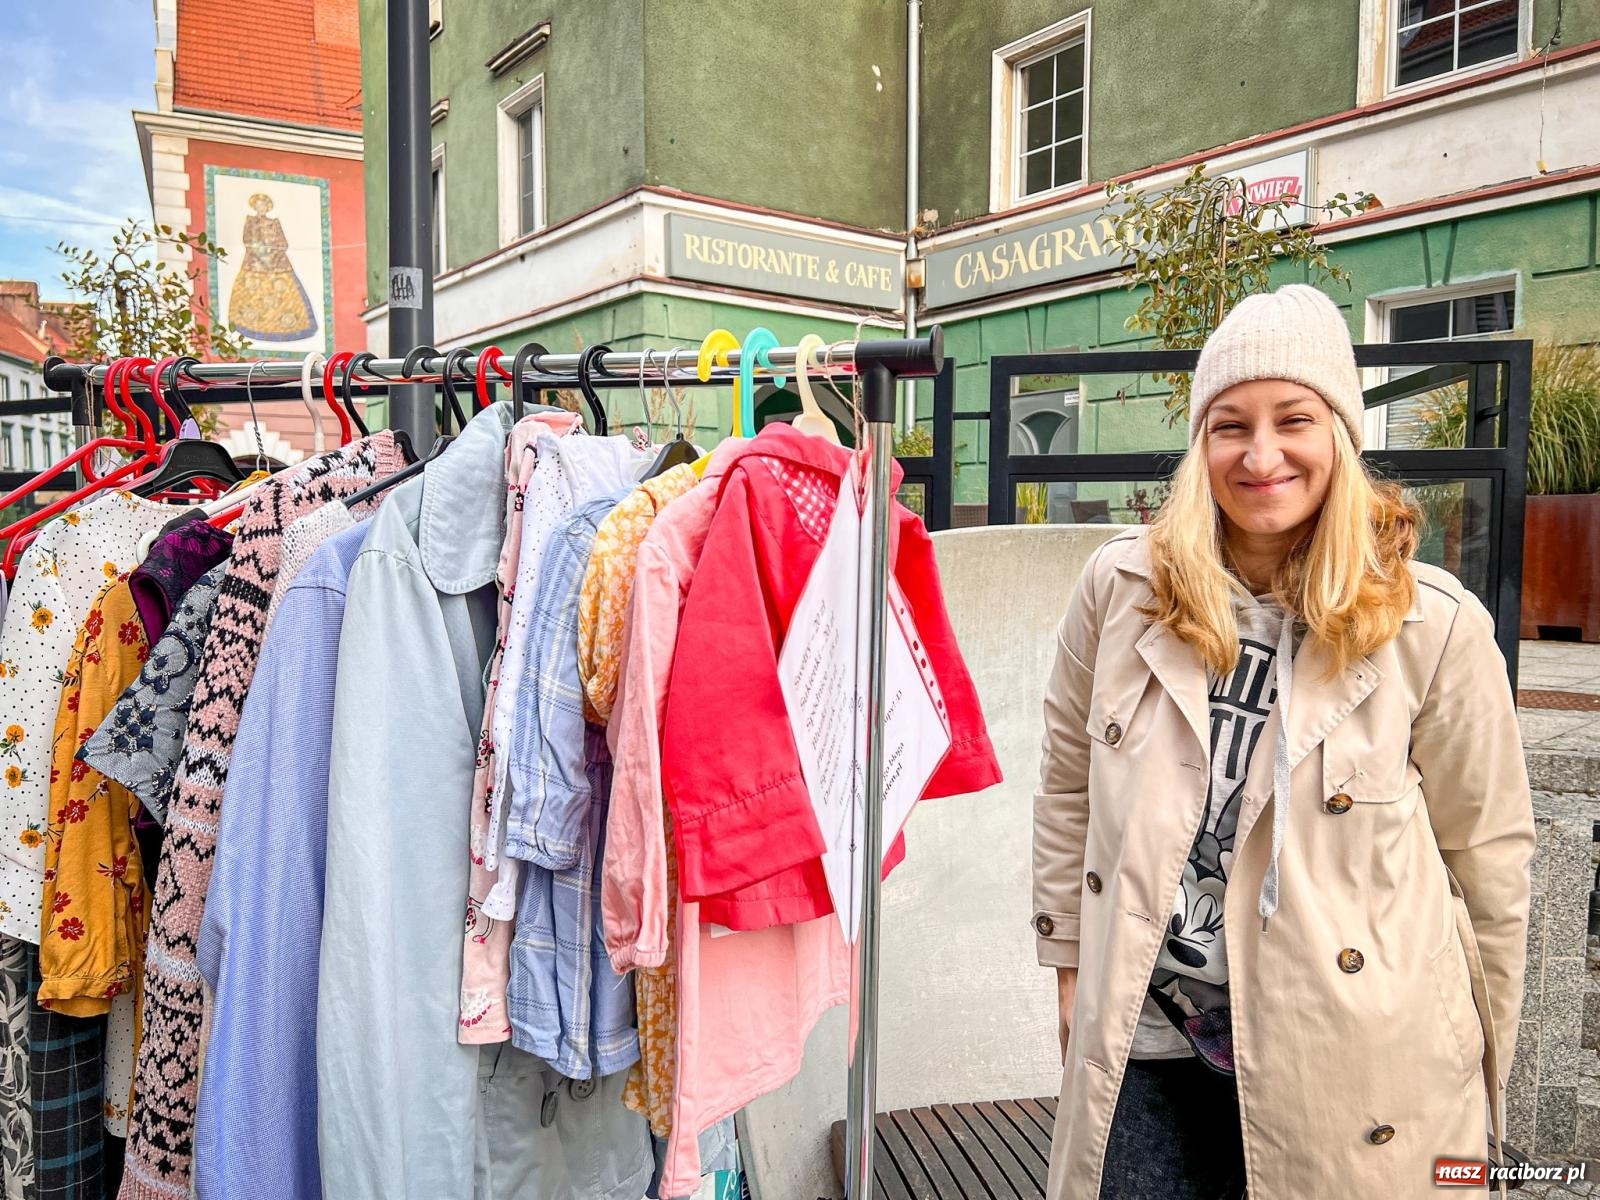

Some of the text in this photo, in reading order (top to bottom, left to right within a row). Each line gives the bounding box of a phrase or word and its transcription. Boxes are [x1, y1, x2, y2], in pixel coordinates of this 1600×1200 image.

[684, 233, 892, 292] RISTORANTE & CAFE
